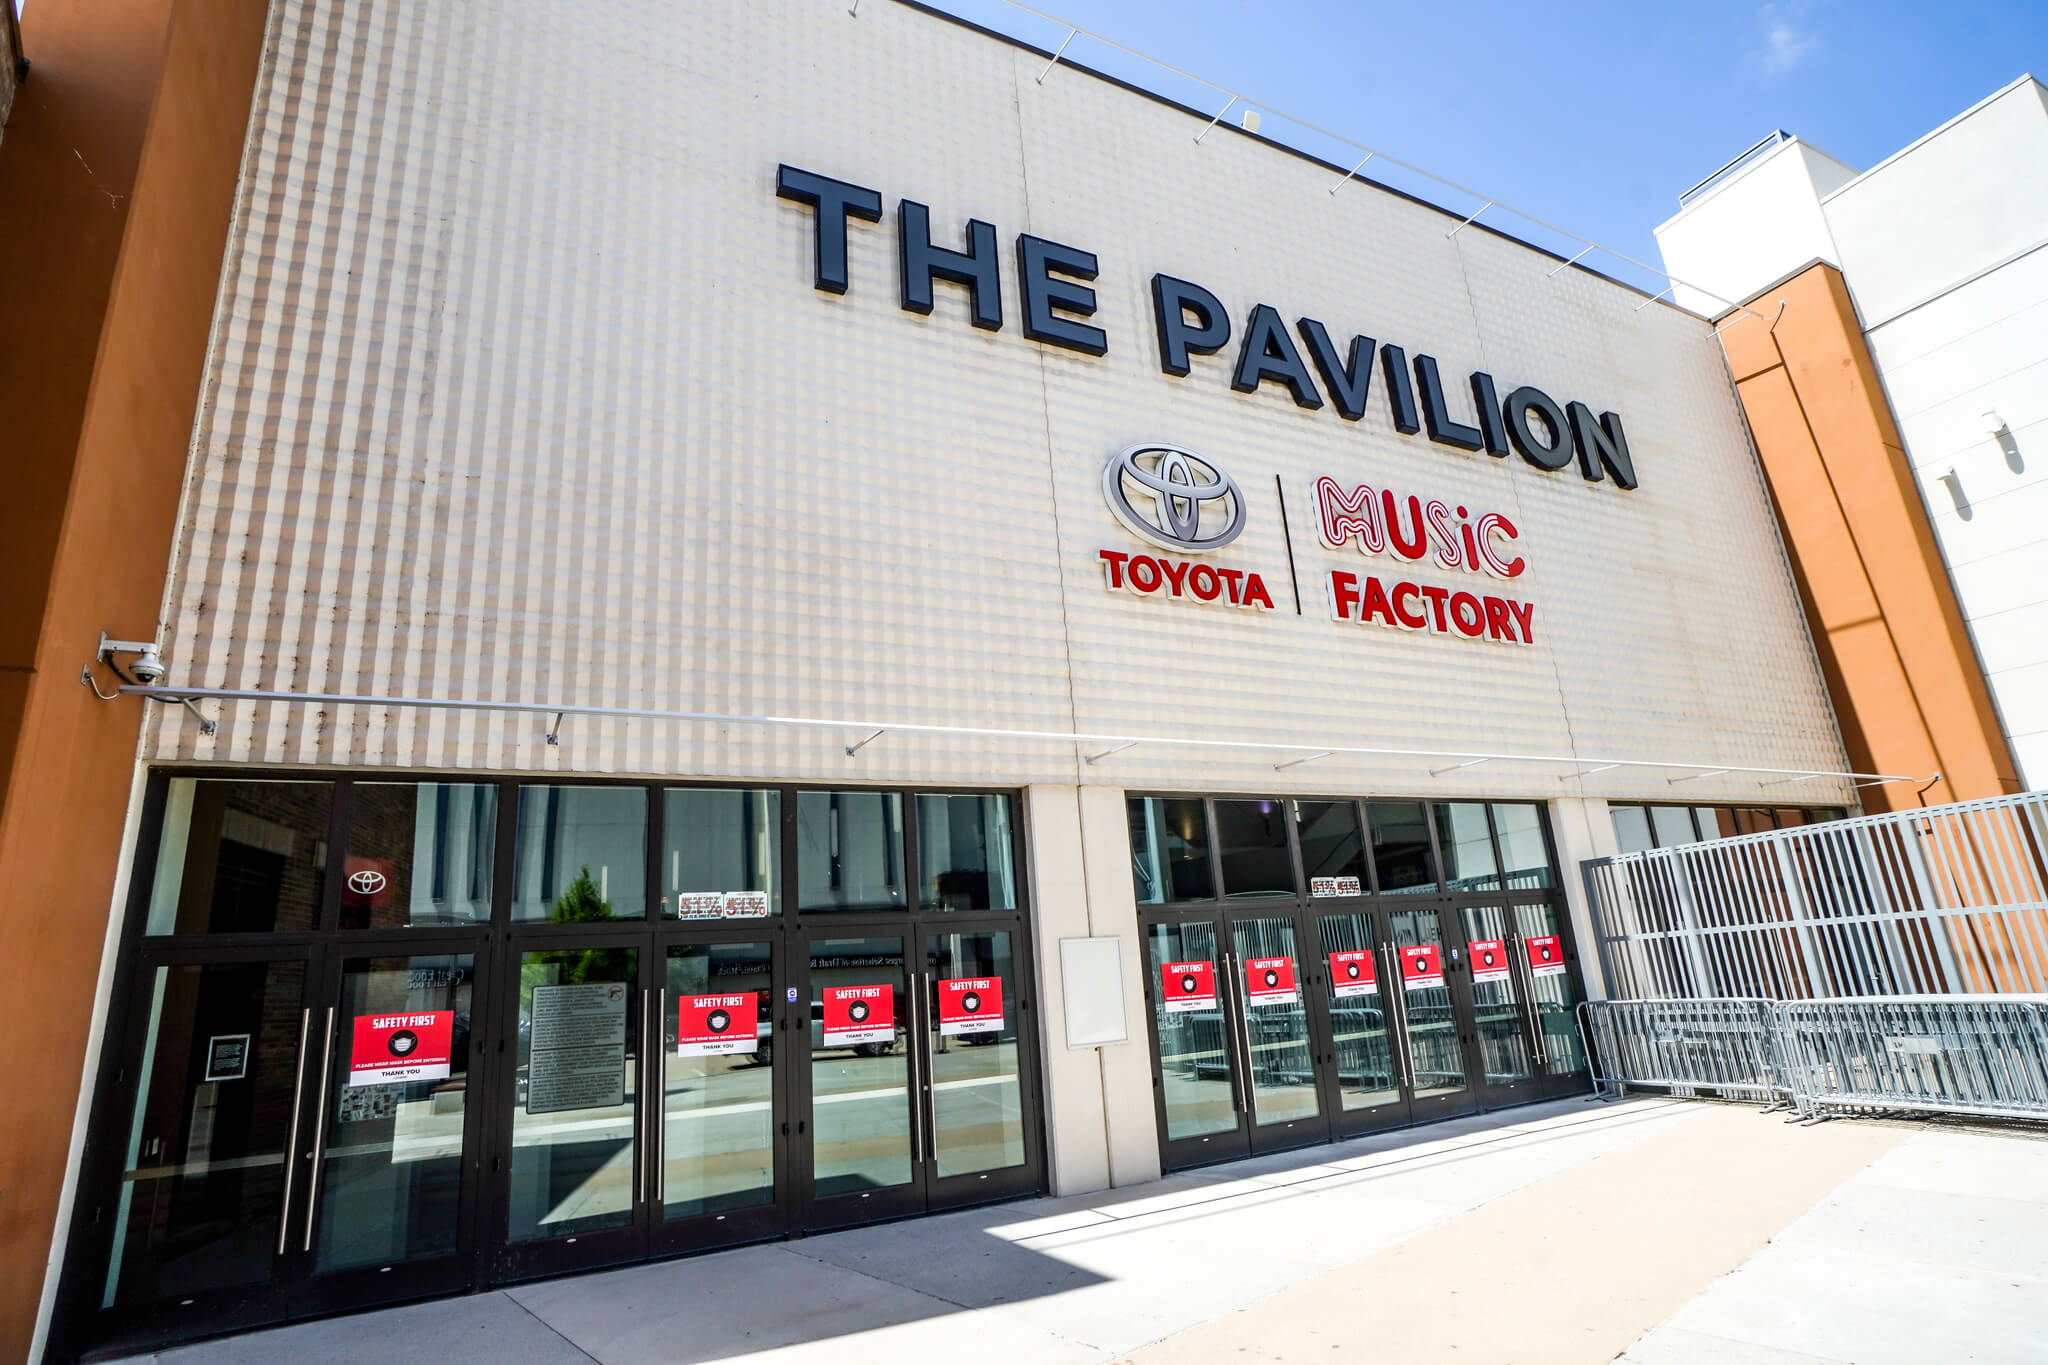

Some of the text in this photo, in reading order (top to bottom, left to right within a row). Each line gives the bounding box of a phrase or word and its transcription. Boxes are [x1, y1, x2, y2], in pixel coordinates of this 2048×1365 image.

[776, 162, 1639, 491] THE PAVILION
[1097, 549, 1276, 612] TOYOTA
[1327, 570, 1534, 647] FACTORY
[680, 897, 723, 915] 51%
[725, 898, 766, 916] 51%
[1171, 964, 1204, 974] SAFETY FIRST
[1254, 959, 1284, 969] SAFETY FIRST
[950, 980, 990, 992] SAFETY FIRST
[836, 988, 880, 1000] SAFETY FIRST
[693, 996, 744, 1008] SAFETY FIRST
[372, 1015, 436, 1030] SAFETY FIRST
